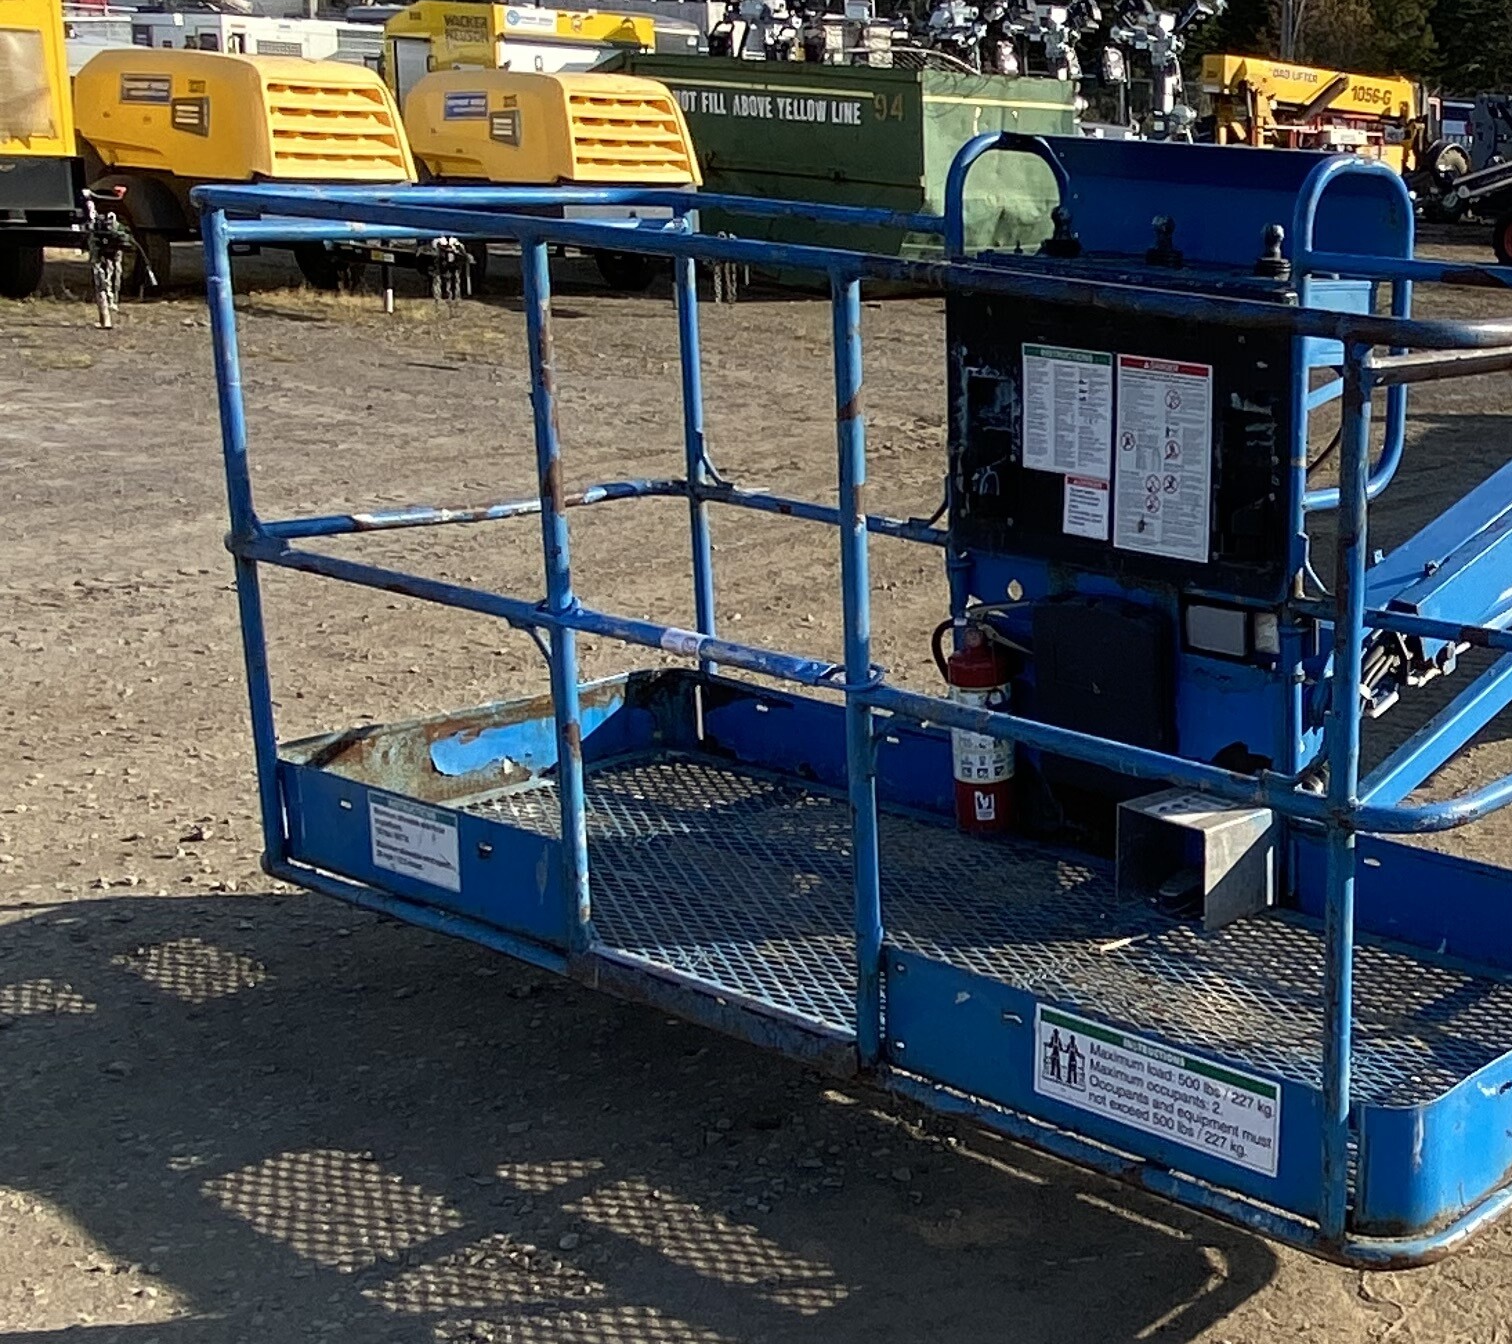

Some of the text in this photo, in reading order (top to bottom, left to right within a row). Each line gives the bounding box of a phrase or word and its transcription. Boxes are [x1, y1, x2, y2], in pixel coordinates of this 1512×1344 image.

[701, 92, 727, 115] FILL
[732, 94, 773, 119] ABOVE
[777, 97, 828, 123] YELLOW
[831, 100, 862, 125] LINE
[874, 93, 904, 122] 94
[1089, 1058, 1144, 1089] Maximum
[1146, 1081, 1207, 1112] occupants:
[1090, 1042, 1144, 1072] Maximum
[1147, 1061, 1176, 1081] load:
[1178, 1072, 1200, 1091] 500
[1203, 1080, 1221, 1099] lbs
[1231, 1090, 1255, 1109] 227
[1088, 1090, 1107, 1106] not
[1109, 1099, 1150, 1122] exceed
[1152, 1112, 1175, 1130] 500
[1177, 1118, 1195, 1138] lbs
[1204, 1130, 1227, 1149] 227
[1089, 1075, 1273, 1149] Occupants and equipment must
